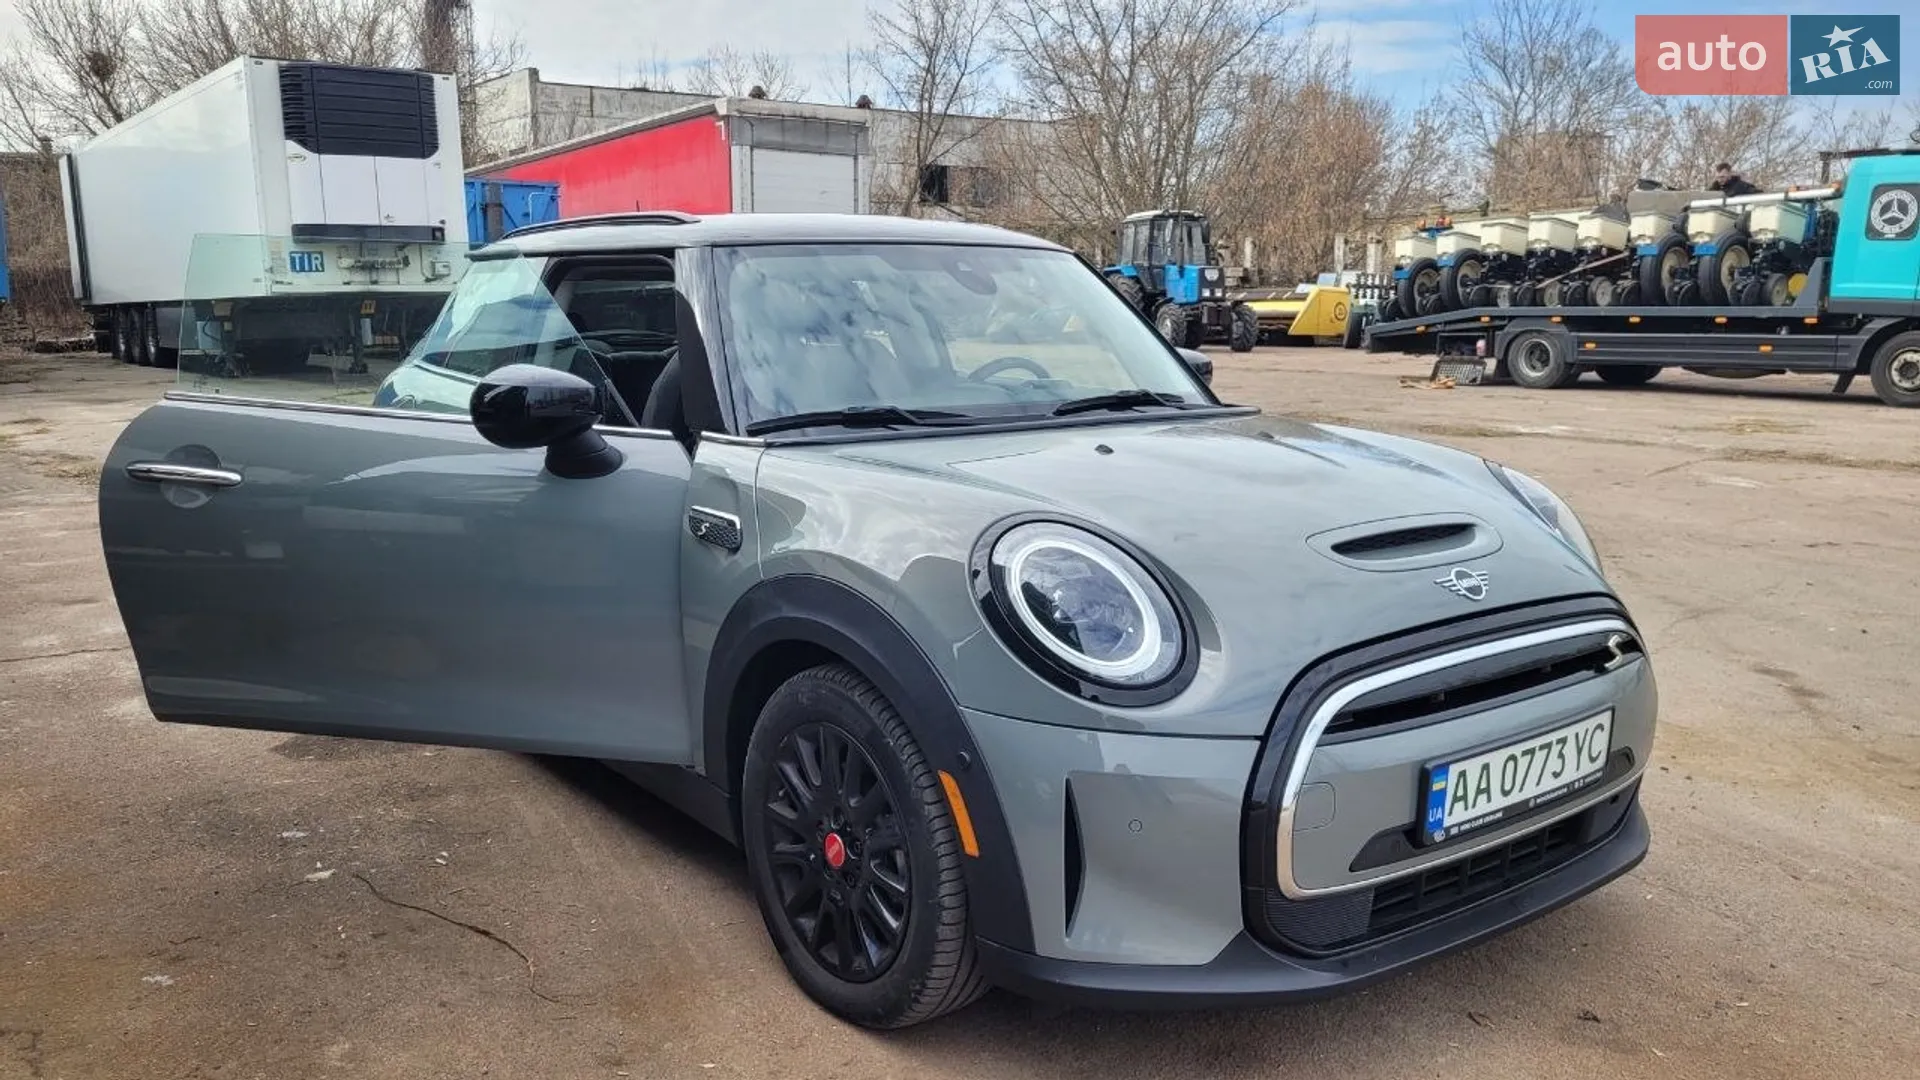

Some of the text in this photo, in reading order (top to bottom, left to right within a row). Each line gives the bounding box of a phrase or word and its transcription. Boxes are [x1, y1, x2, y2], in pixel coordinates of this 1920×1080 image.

[290, 252, 323, 272] TIR
[1447, 762, 1493, 817] AA
[1500, 733, 1569, 798] 0773
[1574, 722, 1606, 772] YC
[1429, 806, 1443, 822] UA
